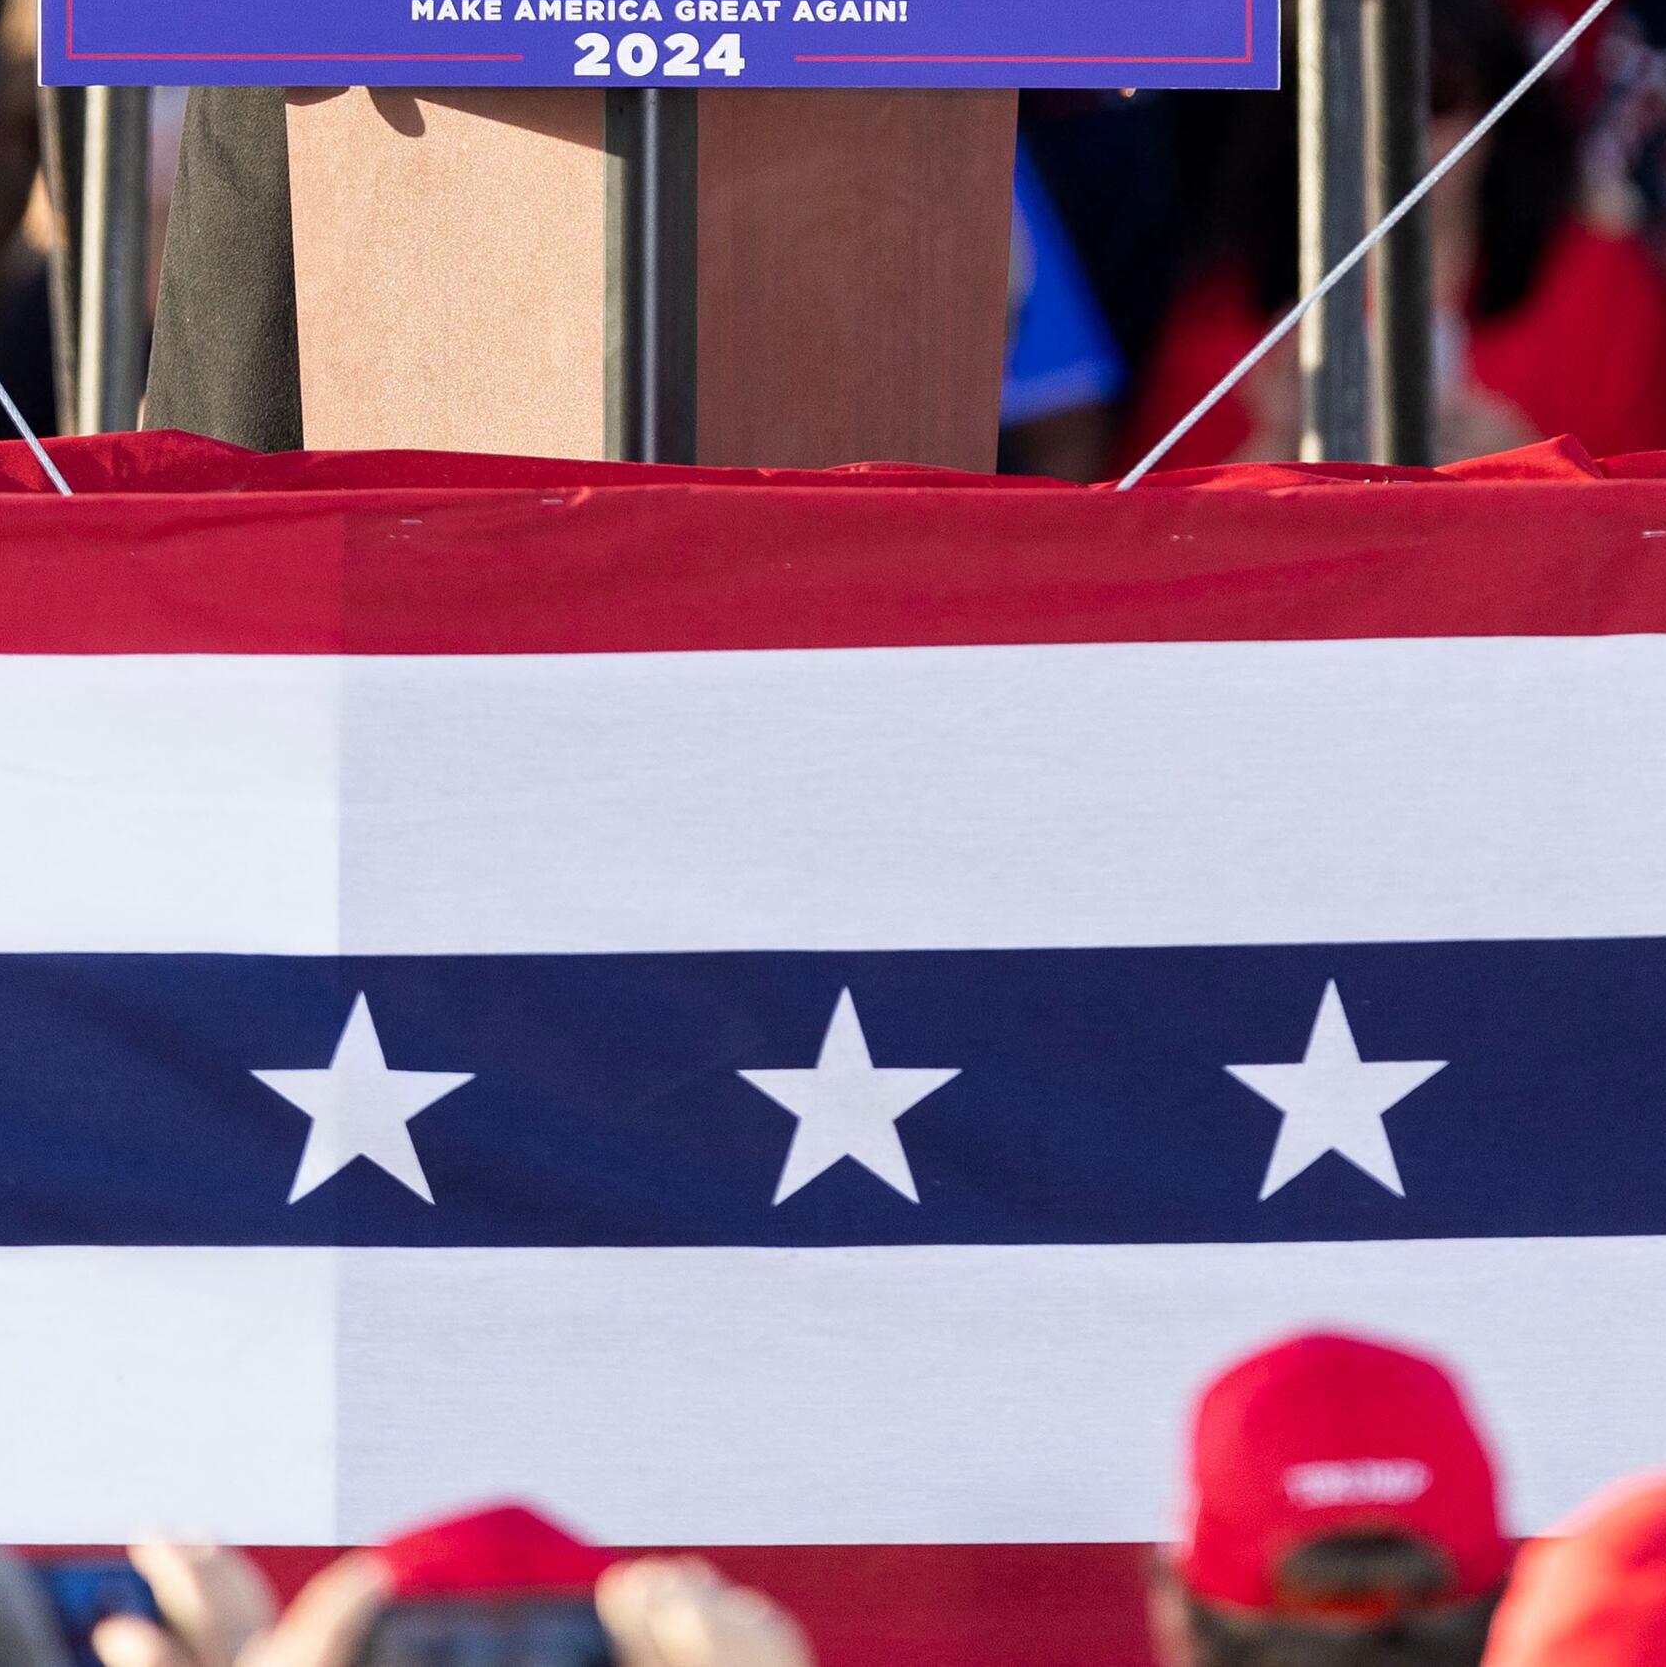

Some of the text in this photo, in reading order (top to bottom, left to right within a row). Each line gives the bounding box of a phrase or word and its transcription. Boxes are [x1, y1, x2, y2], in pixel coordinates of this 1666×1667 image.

[411, 0, 908, 23] MAKE AMERICA GREAT AGAIN!
[574, 32, 746, 77] 2024
